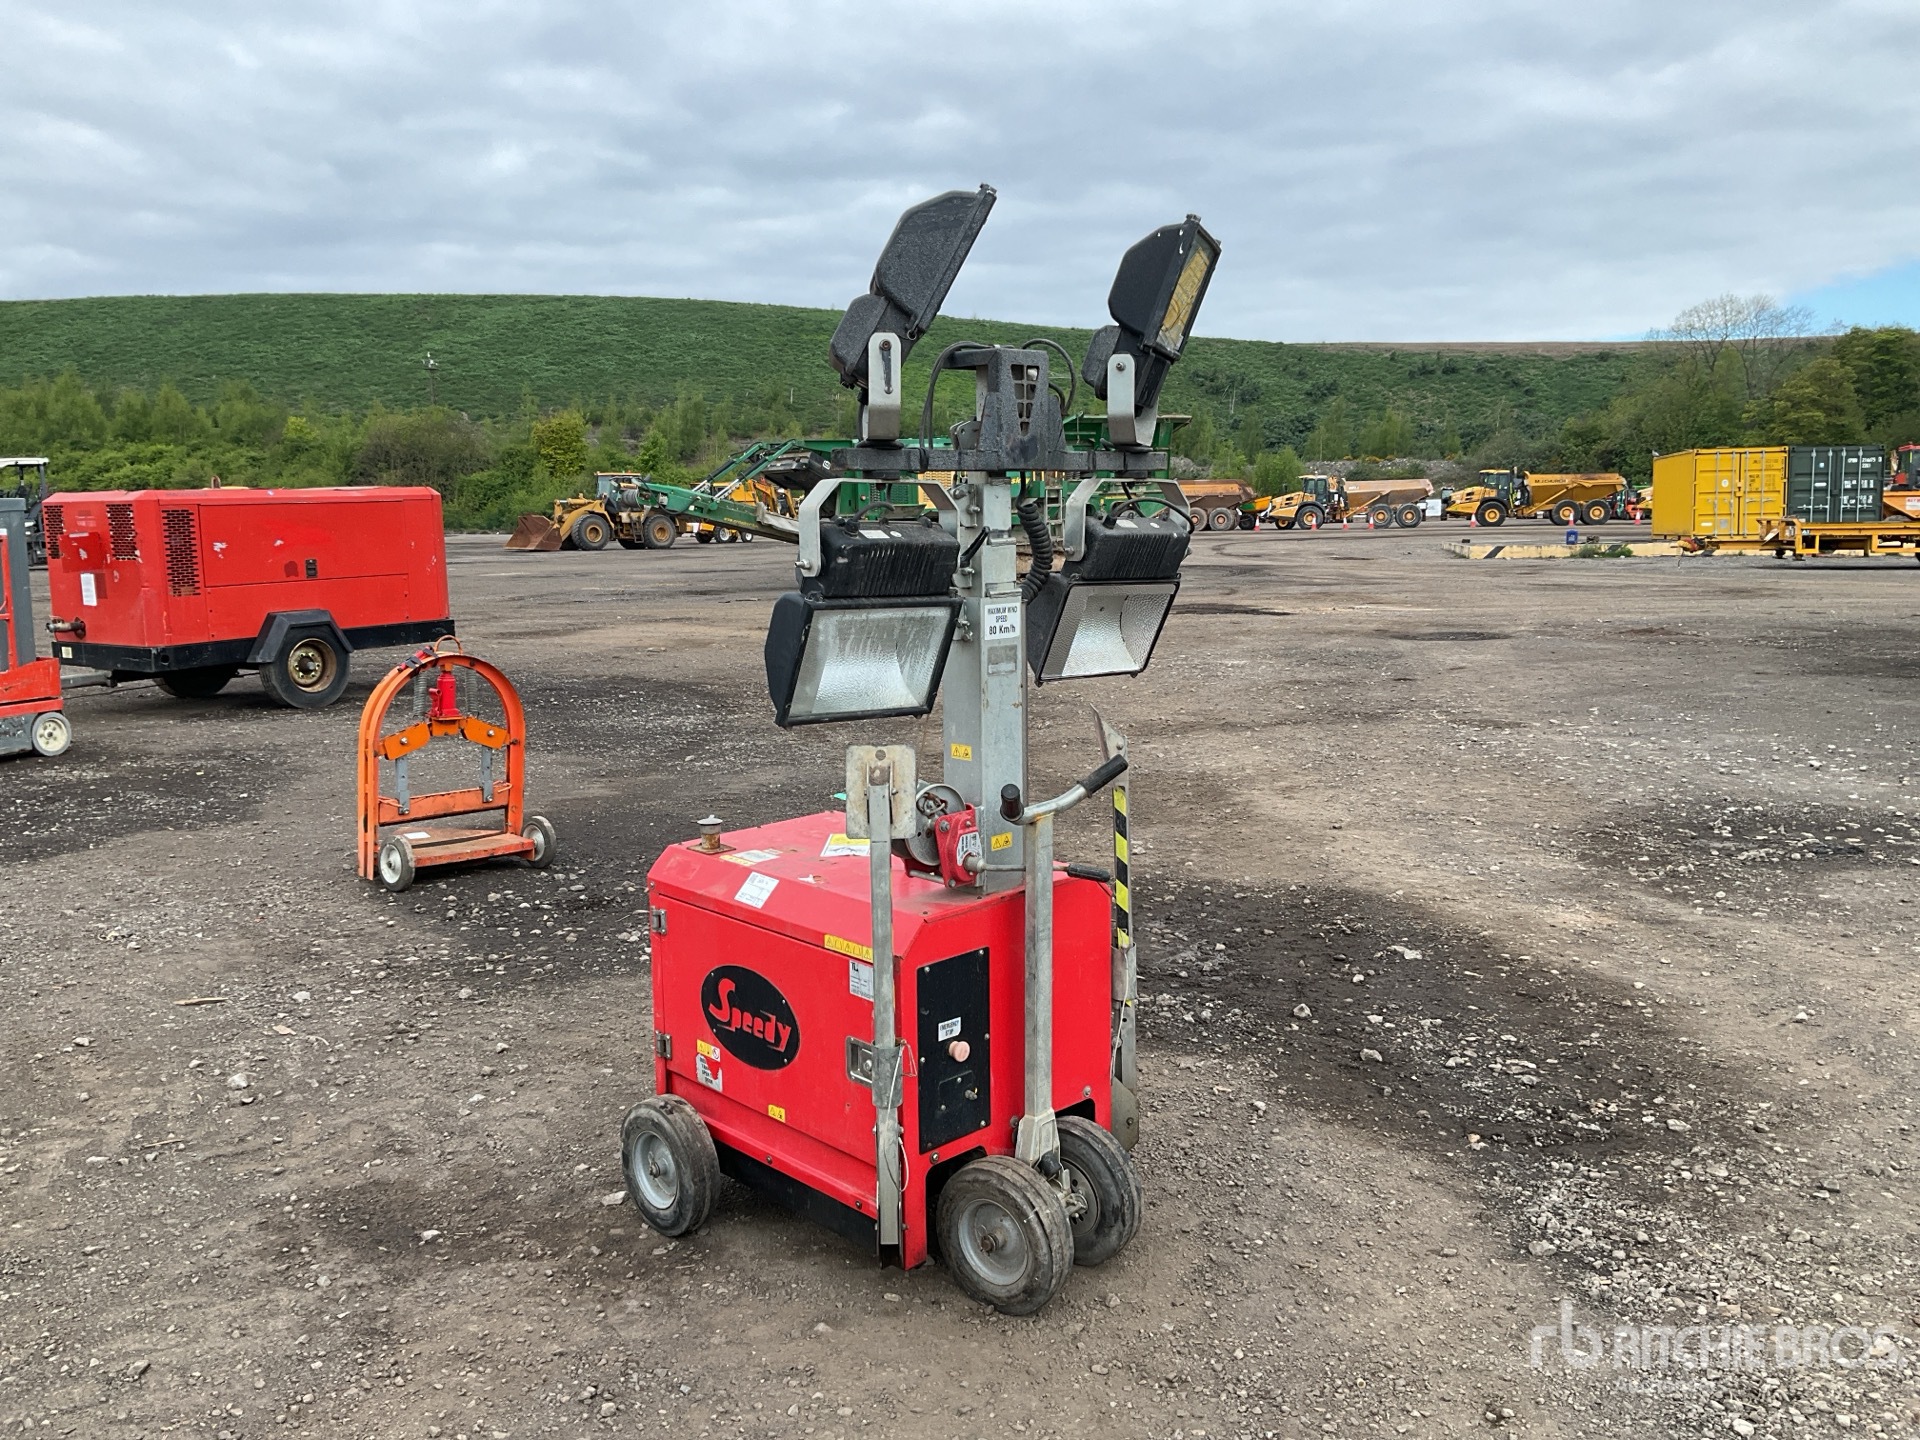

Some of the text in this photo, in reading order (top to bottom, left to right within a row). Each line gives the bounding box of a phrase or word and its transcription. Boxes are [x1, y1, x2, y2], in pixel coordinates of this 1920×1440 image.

[989, 624, 1016, 635] 80 Km/h
[708, 978, 792, 1052] Speedy
